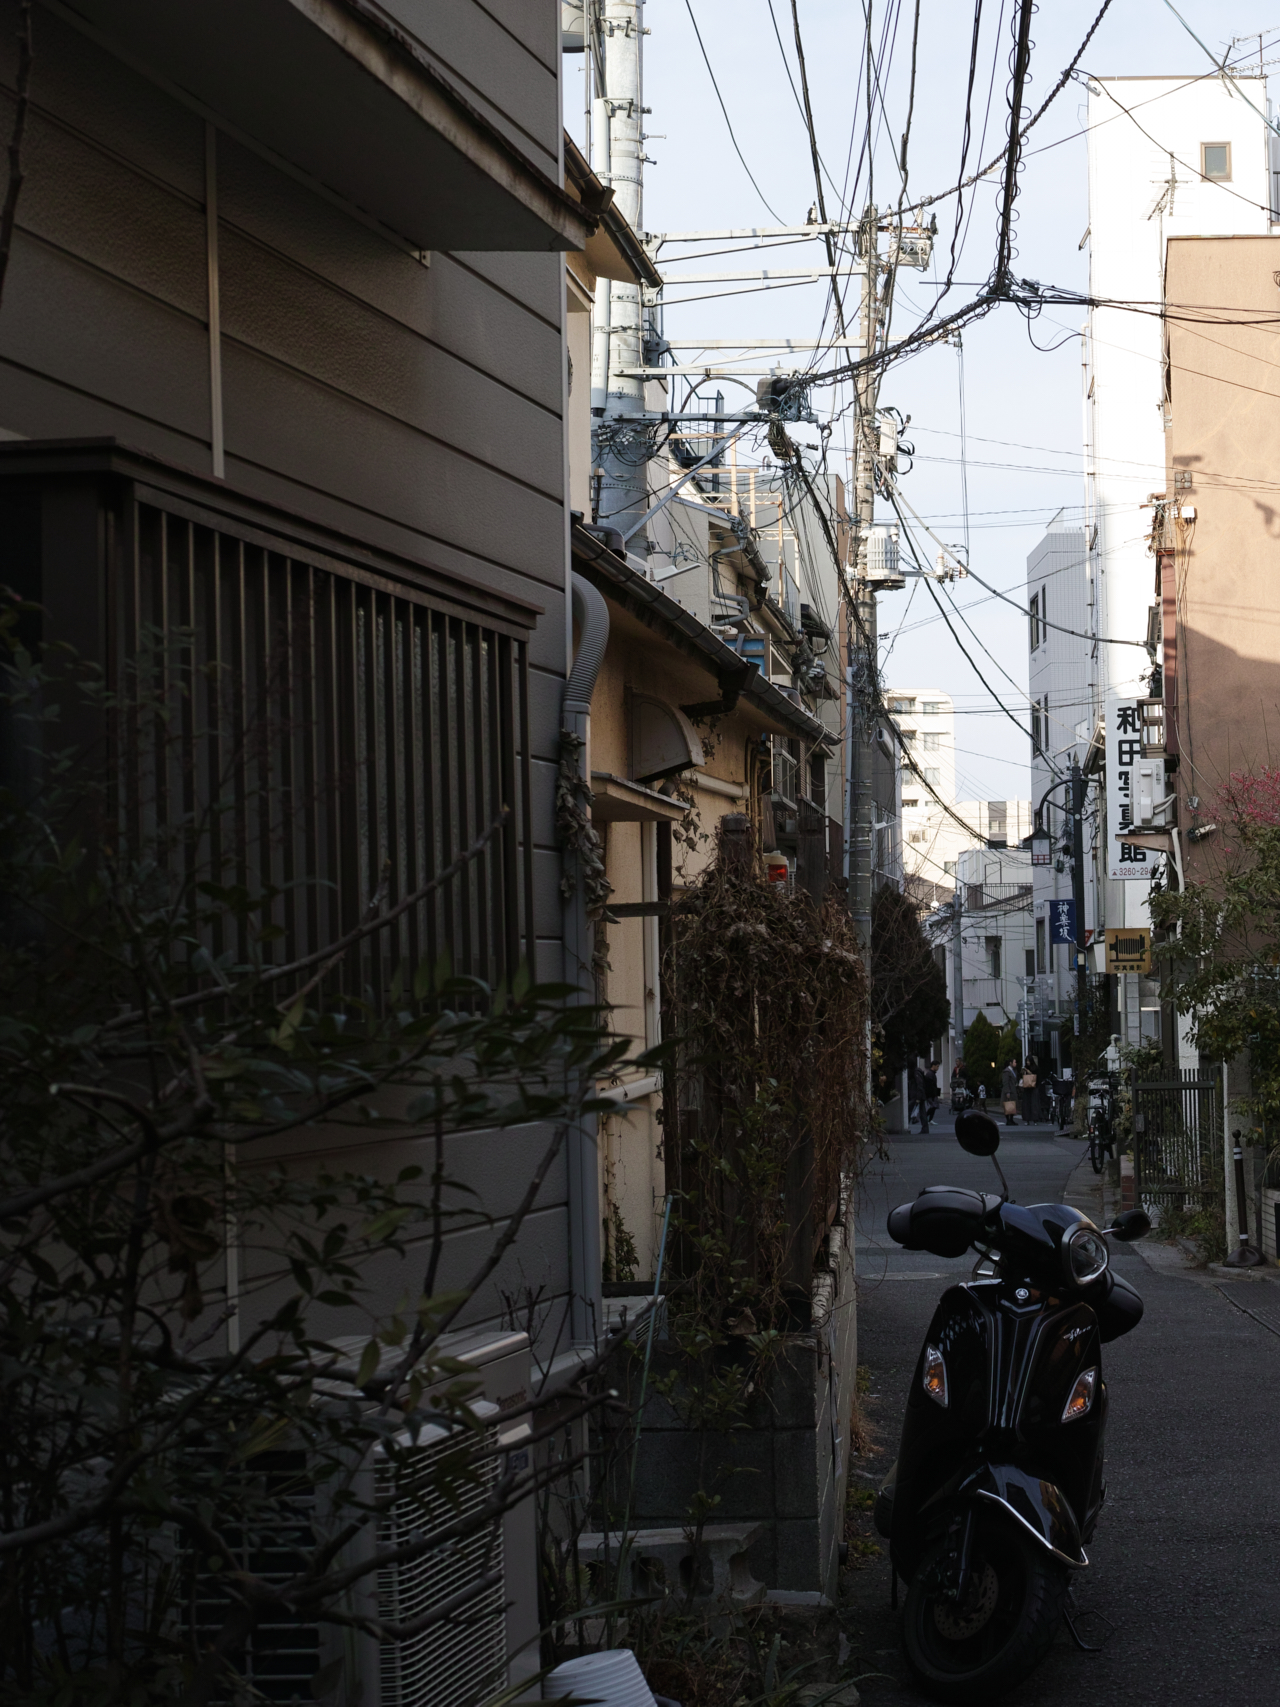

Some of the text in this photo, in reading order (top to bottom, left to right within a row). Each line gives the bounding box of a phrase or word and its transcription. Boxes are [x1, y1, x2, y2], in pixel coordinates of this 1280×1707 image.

[1119, 867, 1153, 876] 3260-294
[1055, 902, 1073, 940] 神楽坂
